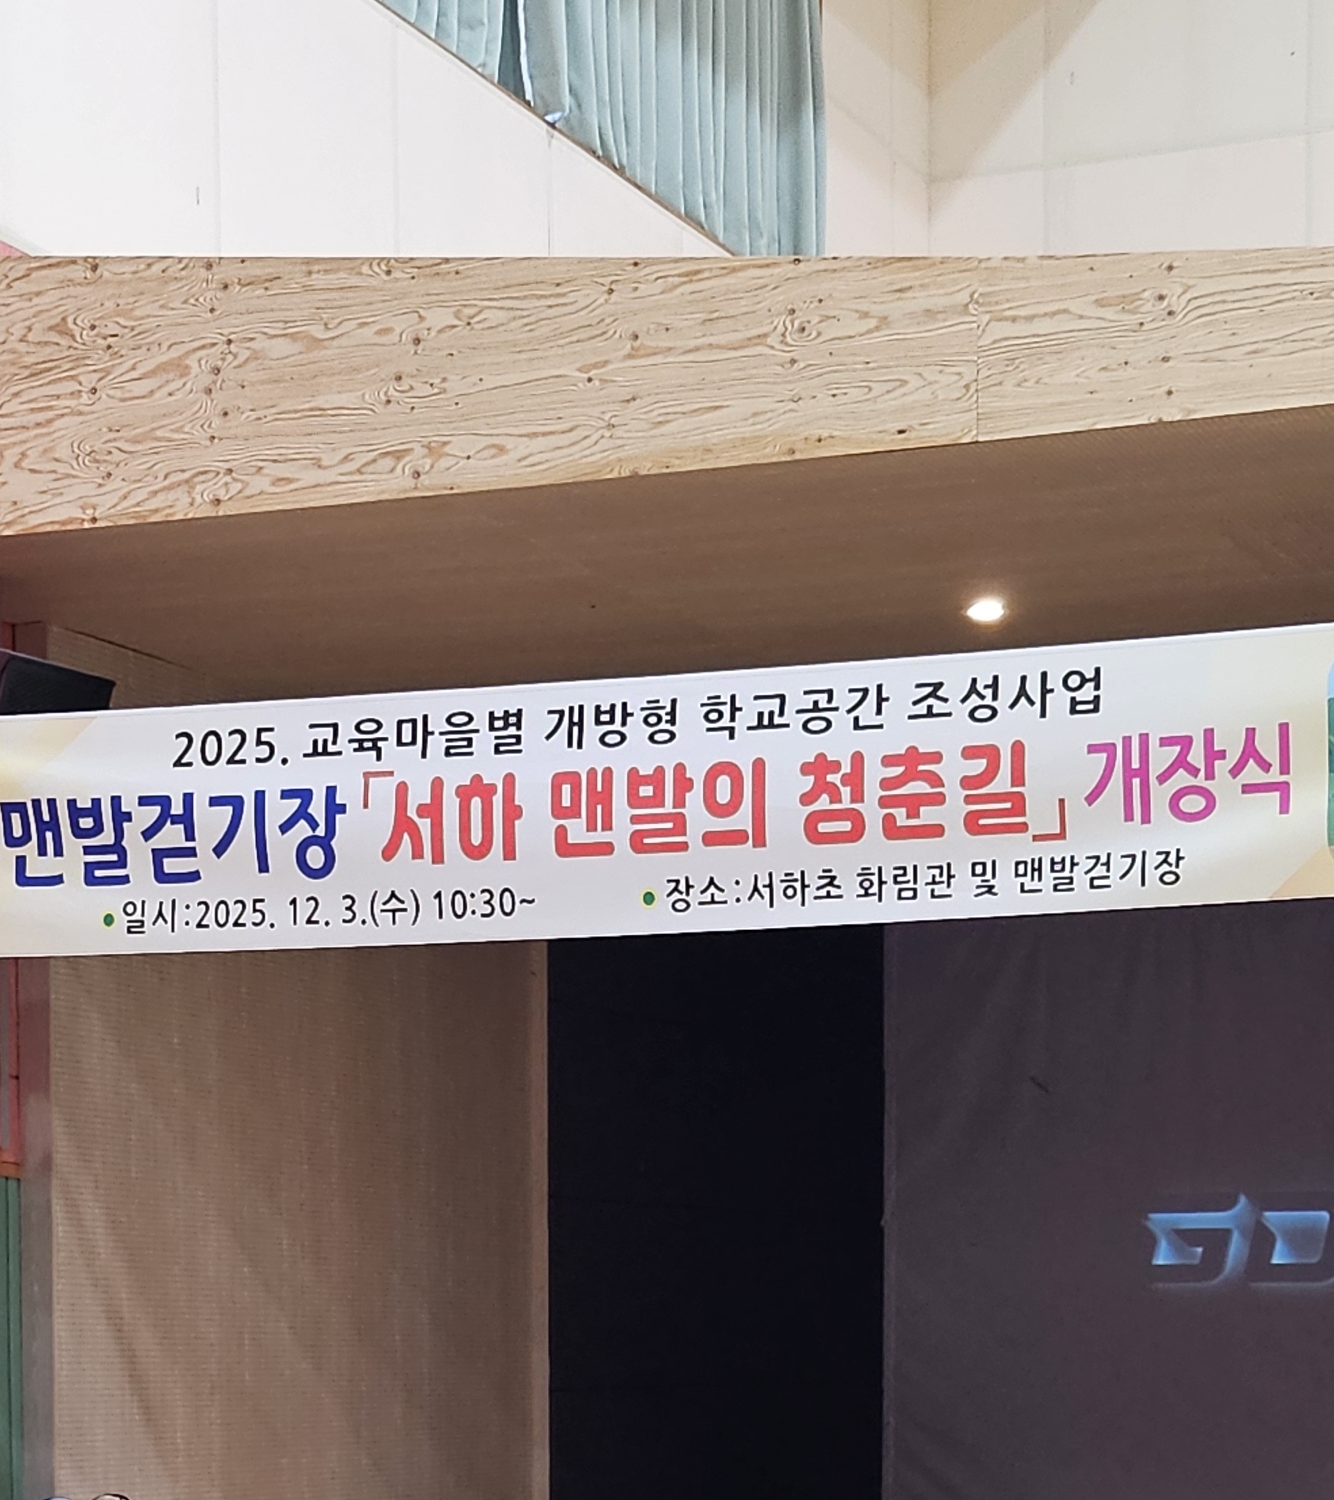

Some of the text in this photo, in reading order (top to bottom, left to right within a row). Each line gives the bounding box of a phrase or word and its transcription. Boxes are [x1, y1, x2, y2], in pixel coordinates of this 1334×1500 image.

[172, 666, 1102, 769] 2025. 교육마을별 개방형 학교공간 조성사업
[551, 760, 768, 858] 맨발의
[1085, 720, 1295, 828] 개장식
[288, 896, 332, 927] 12.
[432, 887, 537, 921] 10:30~
[665, 848, 1186, 914] 장소:서하초 화림관 및 맨발걷기장
